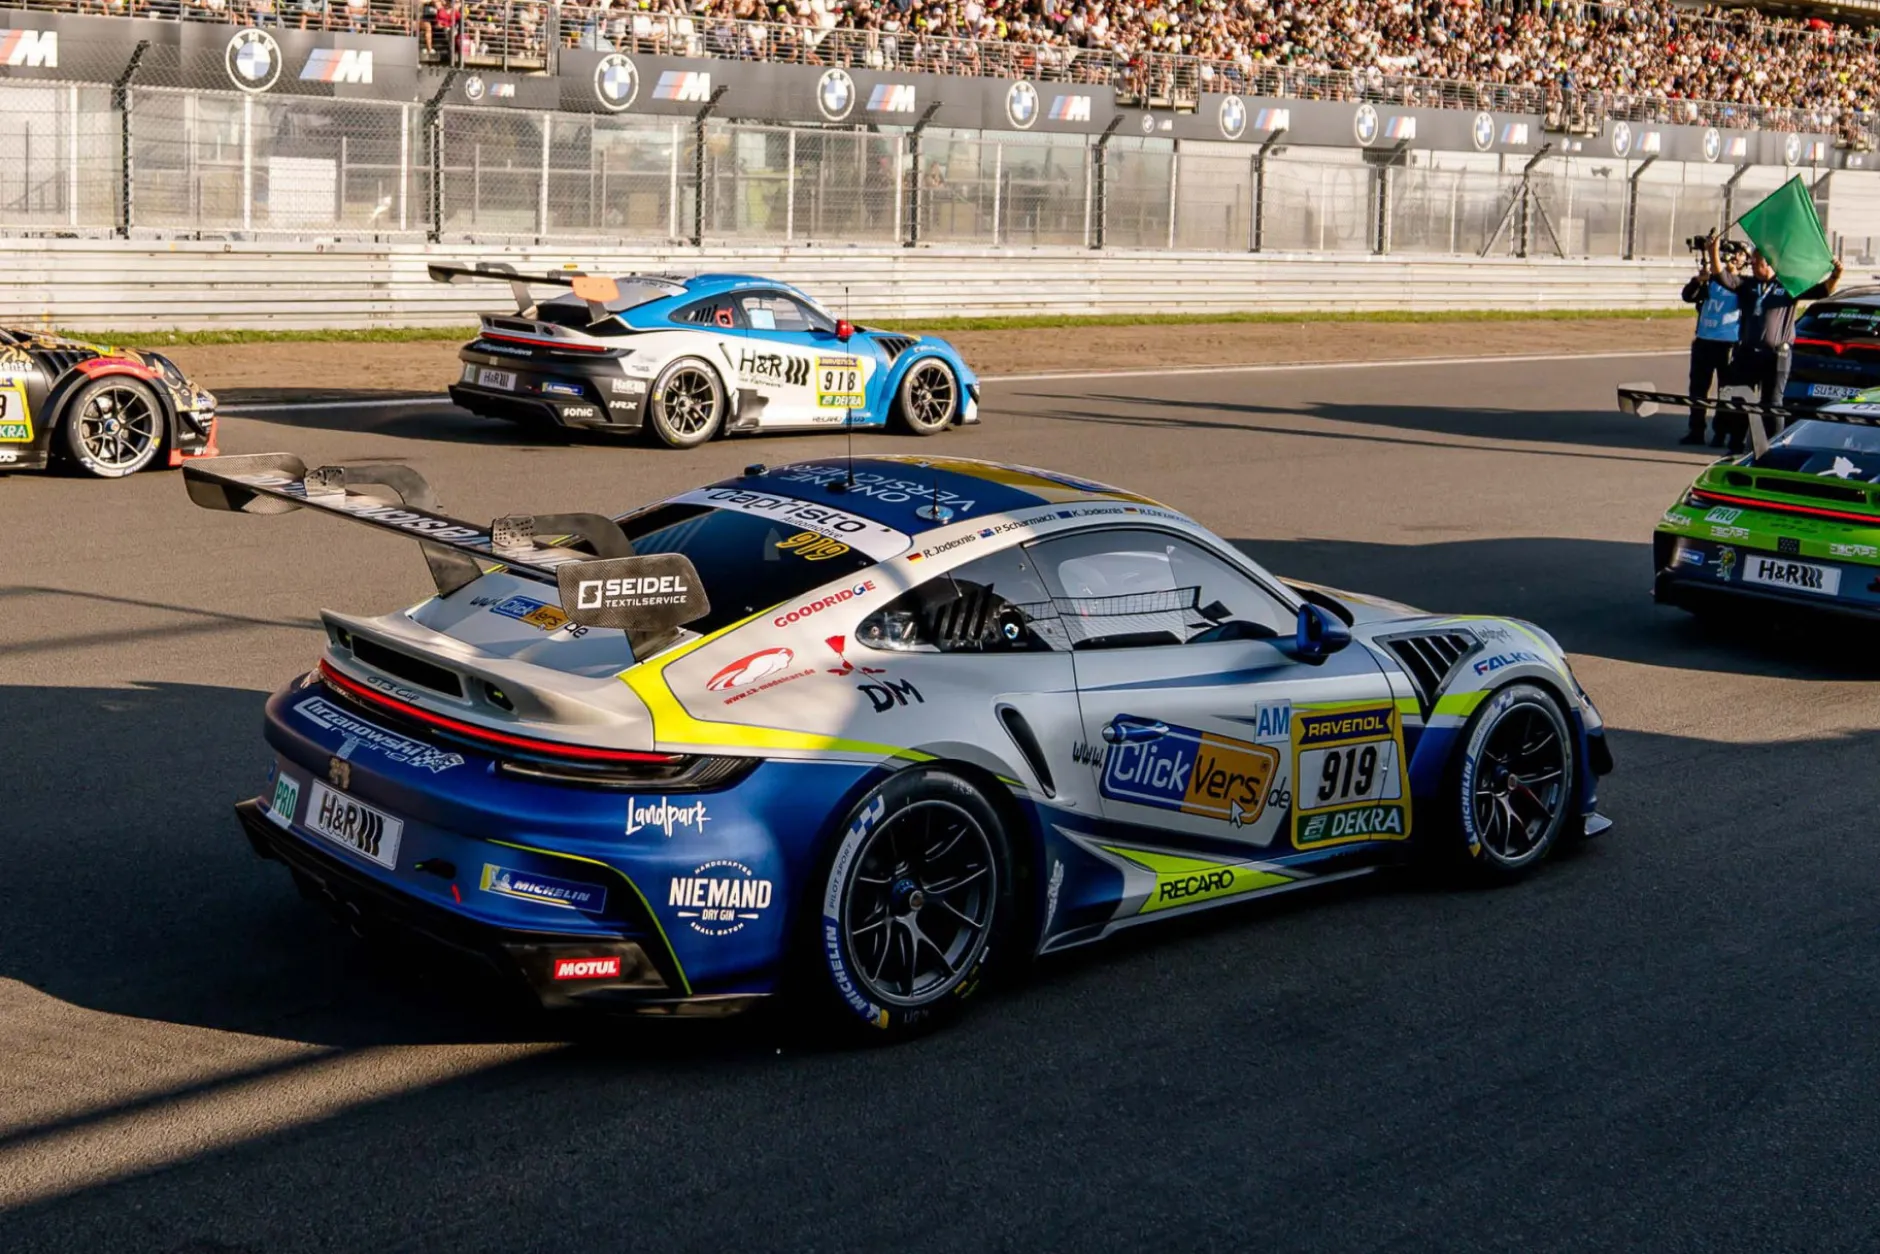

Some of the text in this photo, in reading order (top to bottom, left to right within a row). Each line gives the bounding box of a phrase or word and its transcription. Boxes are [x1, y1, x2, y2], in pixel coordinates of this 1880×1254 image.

[824, 371, 856, 391] 918
[0, 425, 28, 438] KRA
[781, 515, 844, 539] Automotive
[1708, 508, 1737, 521] PRO
[775, 531, 850, 560] 919
[605, 575, 688, 596] SEIDEL
[605, 595, 687, 608] TEXTILSERVICE
[774, 580, 876, 628] GOODRIDGE
[857, 678, 925, 713] DM
[1257, 706, 1290, 737] AM
[1308, 715, 1384, 737] RAVENOL
[1317, 745, 1379, 801] 919
[275, 780, 297, 821] PRO
[1460, 761, 1474, 834] MICHELIN
[625, 796, 711, 838] Landpark
[1331, 807, 1401, 837] DEKRA
[694, 860, 753, 877] HANDCRAFTED
[828, 843, 852, 910] PILOT SPORT
[513, 880, 590, 902] MICHELIN
[668, 877, 772, 909] NIEMAND
[1159, 869, 1235, 902] RECARO
[690, 921, 744, 936] SMALL BATCH
[702, 909, 735, 921] DRY GIN
[558, 961, 618, 977] MOTUL
[825, 924, 868, 1014] MICHELIN
